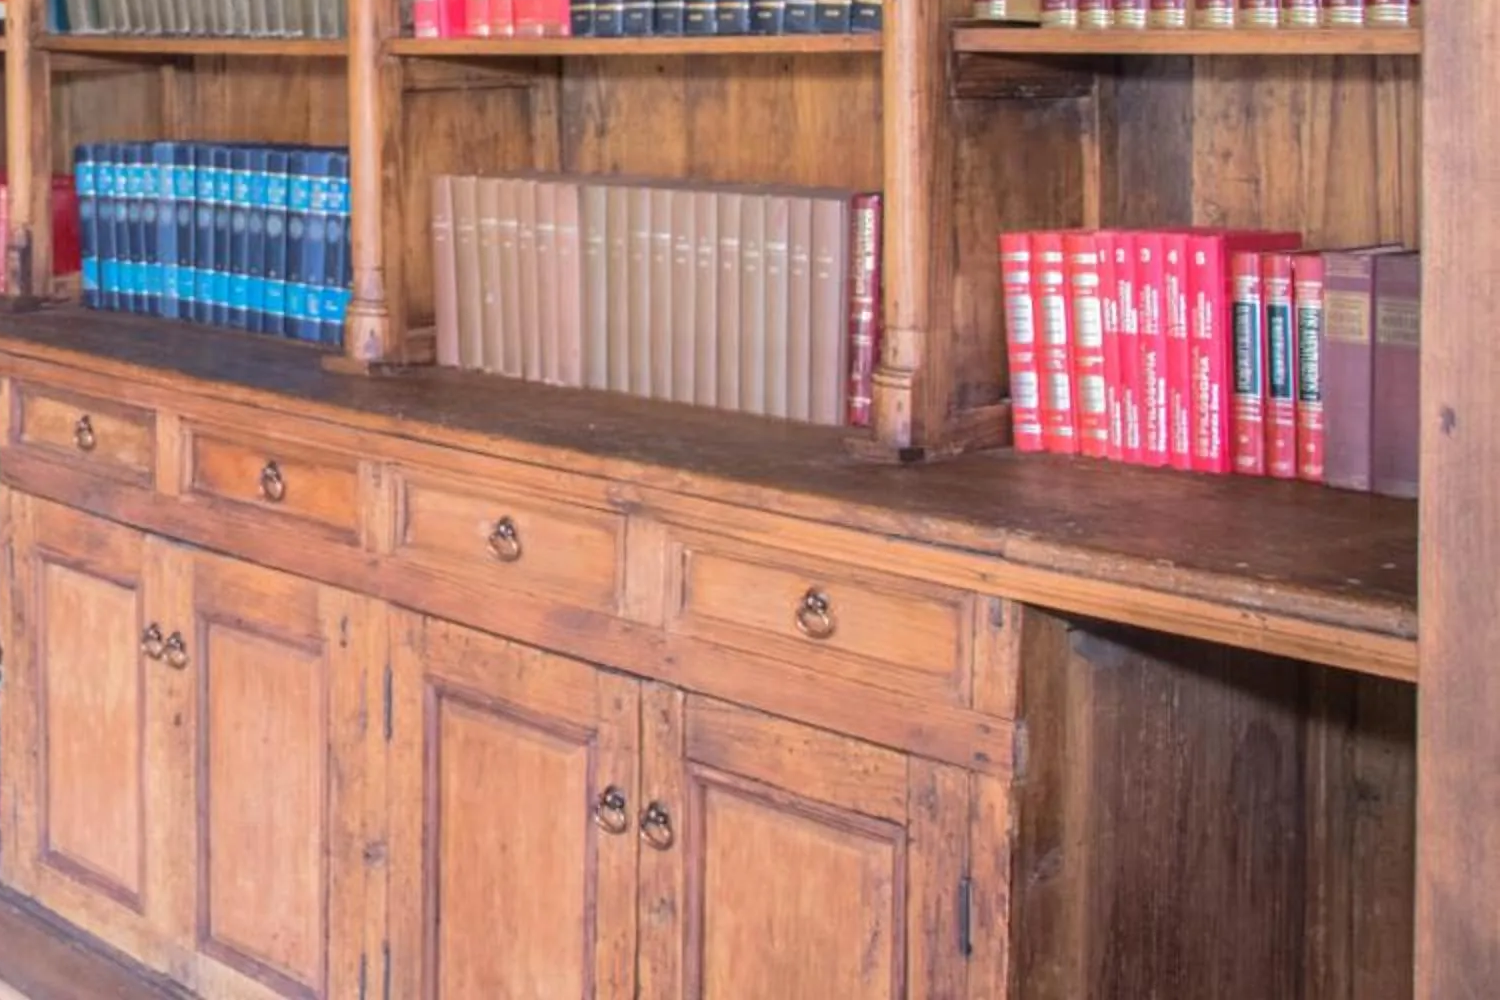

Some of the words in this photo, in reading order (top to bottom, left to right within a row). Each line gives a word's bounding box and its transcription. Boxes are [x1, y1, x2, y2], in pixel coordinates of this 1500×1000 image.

[1115, 247, 1125, 263] 2
[1140, 247, 1151, 263] 3
[1167, 250, 1178, 265] 4
